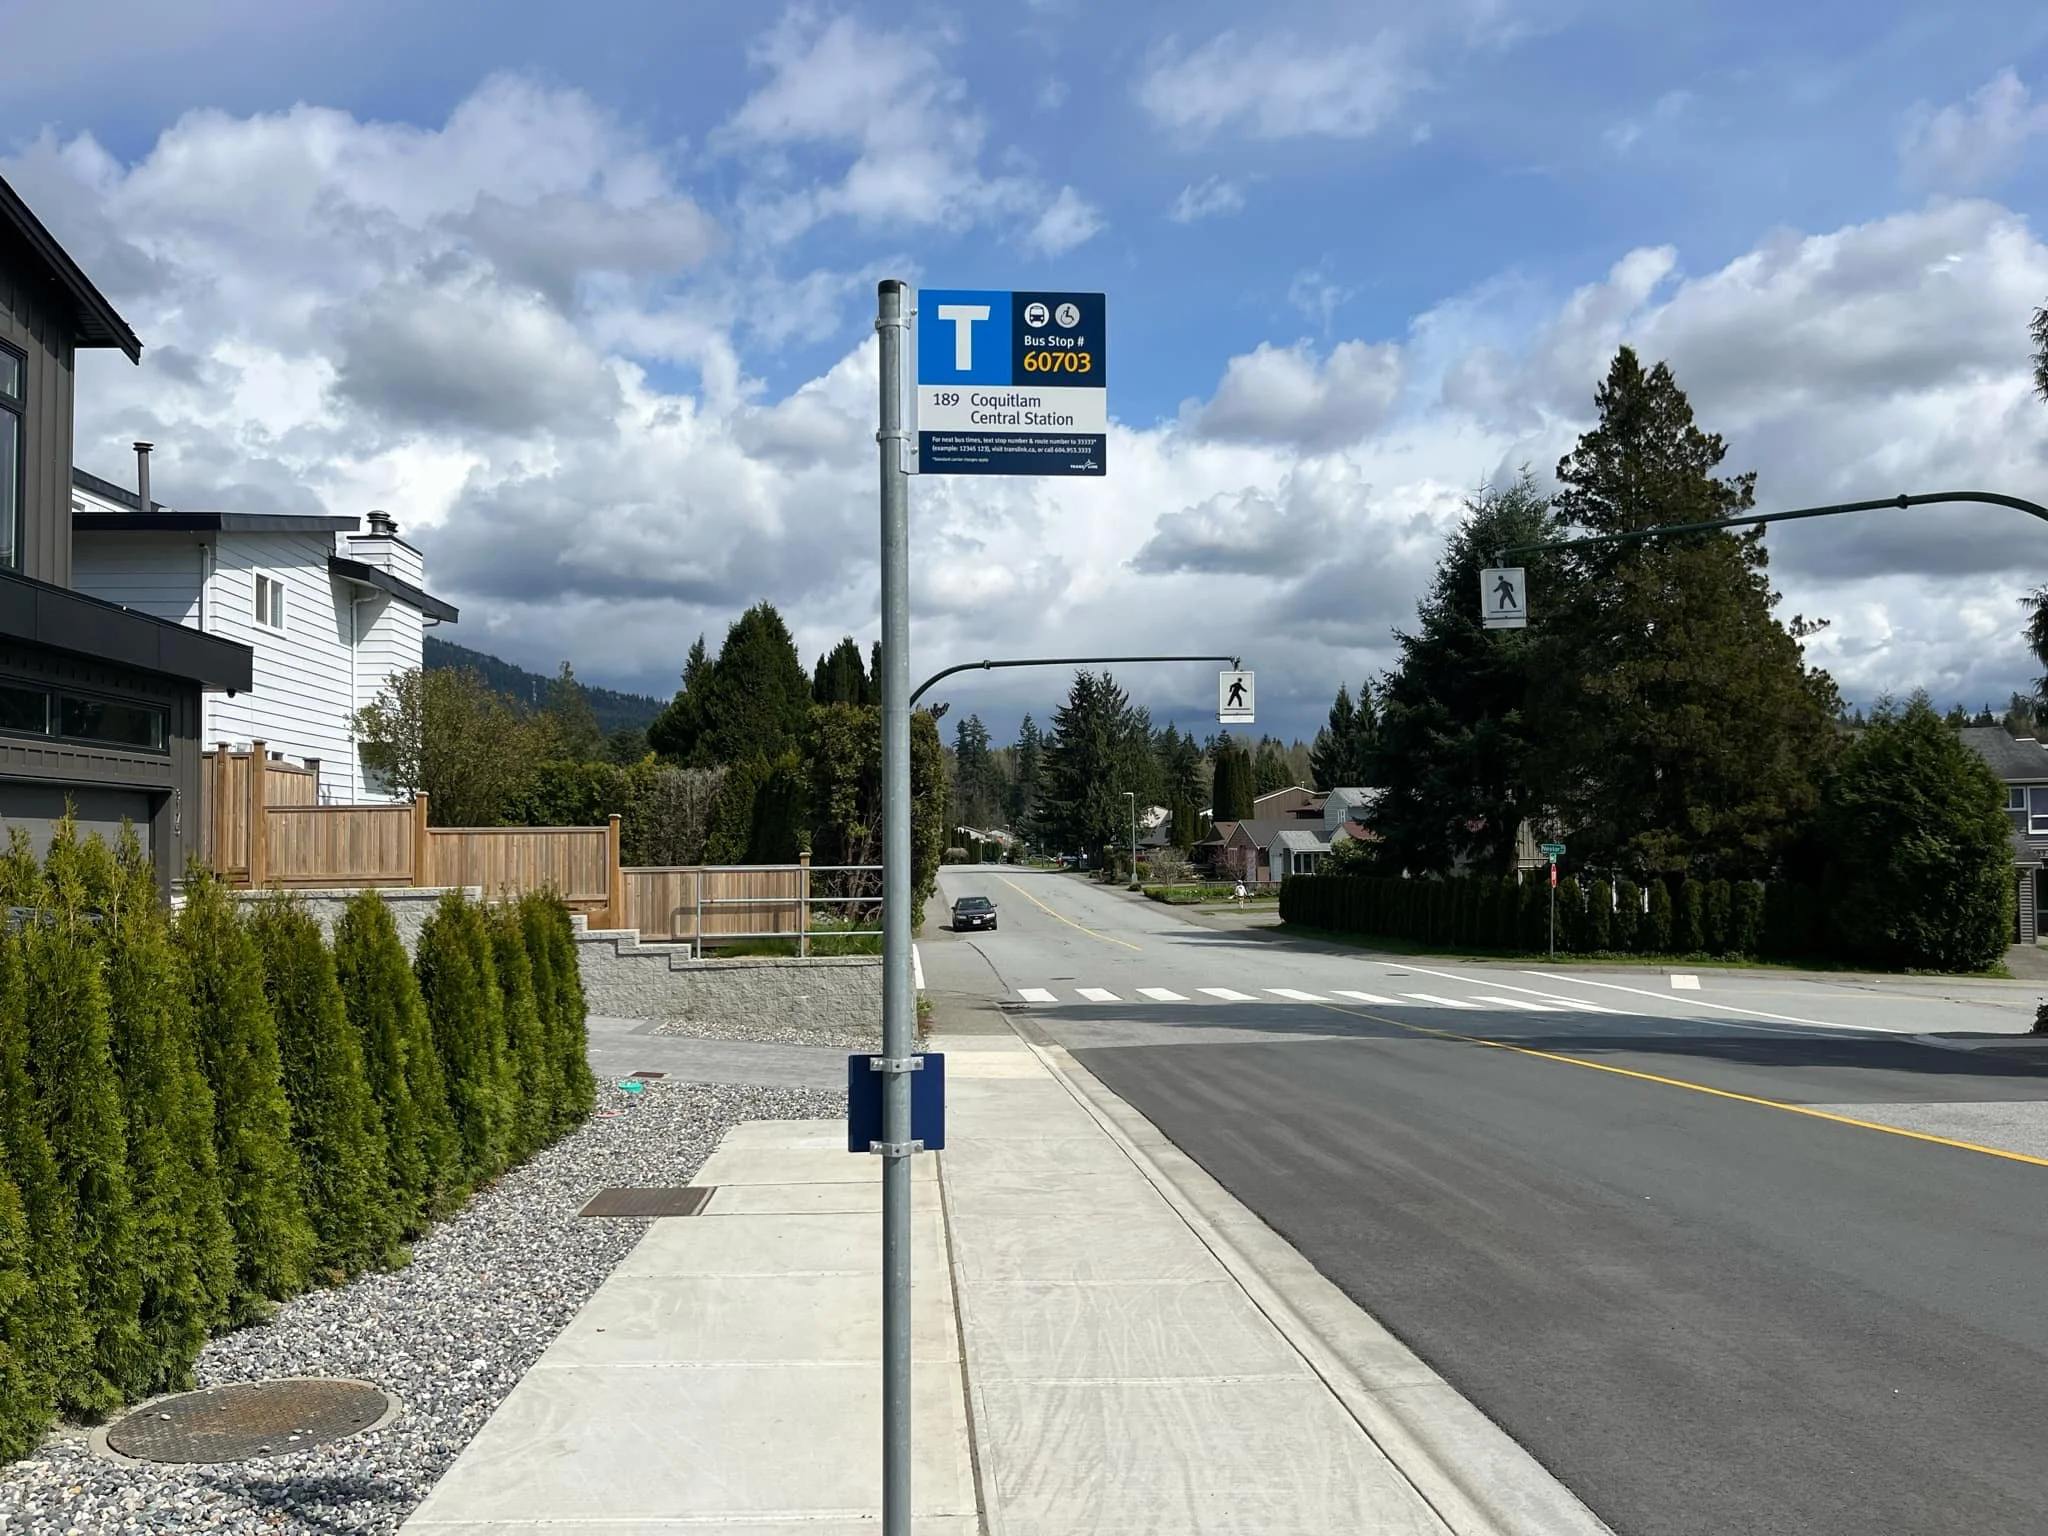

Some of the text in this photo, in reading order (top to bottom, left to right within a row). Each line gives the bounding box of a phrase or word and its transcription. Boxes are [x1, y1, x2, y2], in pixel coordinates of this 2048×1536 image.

[938, 305, 991, 371] T
[1024, 335, 1085, 349] Bus Stop #
[1024, 350, 1092, 373] 60703
[933, 393, 1041, 410] 189 Coquitlam
[970, 410, 1074, 426] Central Station
[965, 436, 983, 444] times,
[994, 437, 1007, 445] stop
[1003, 446, 1037, 454] translink.ca,
